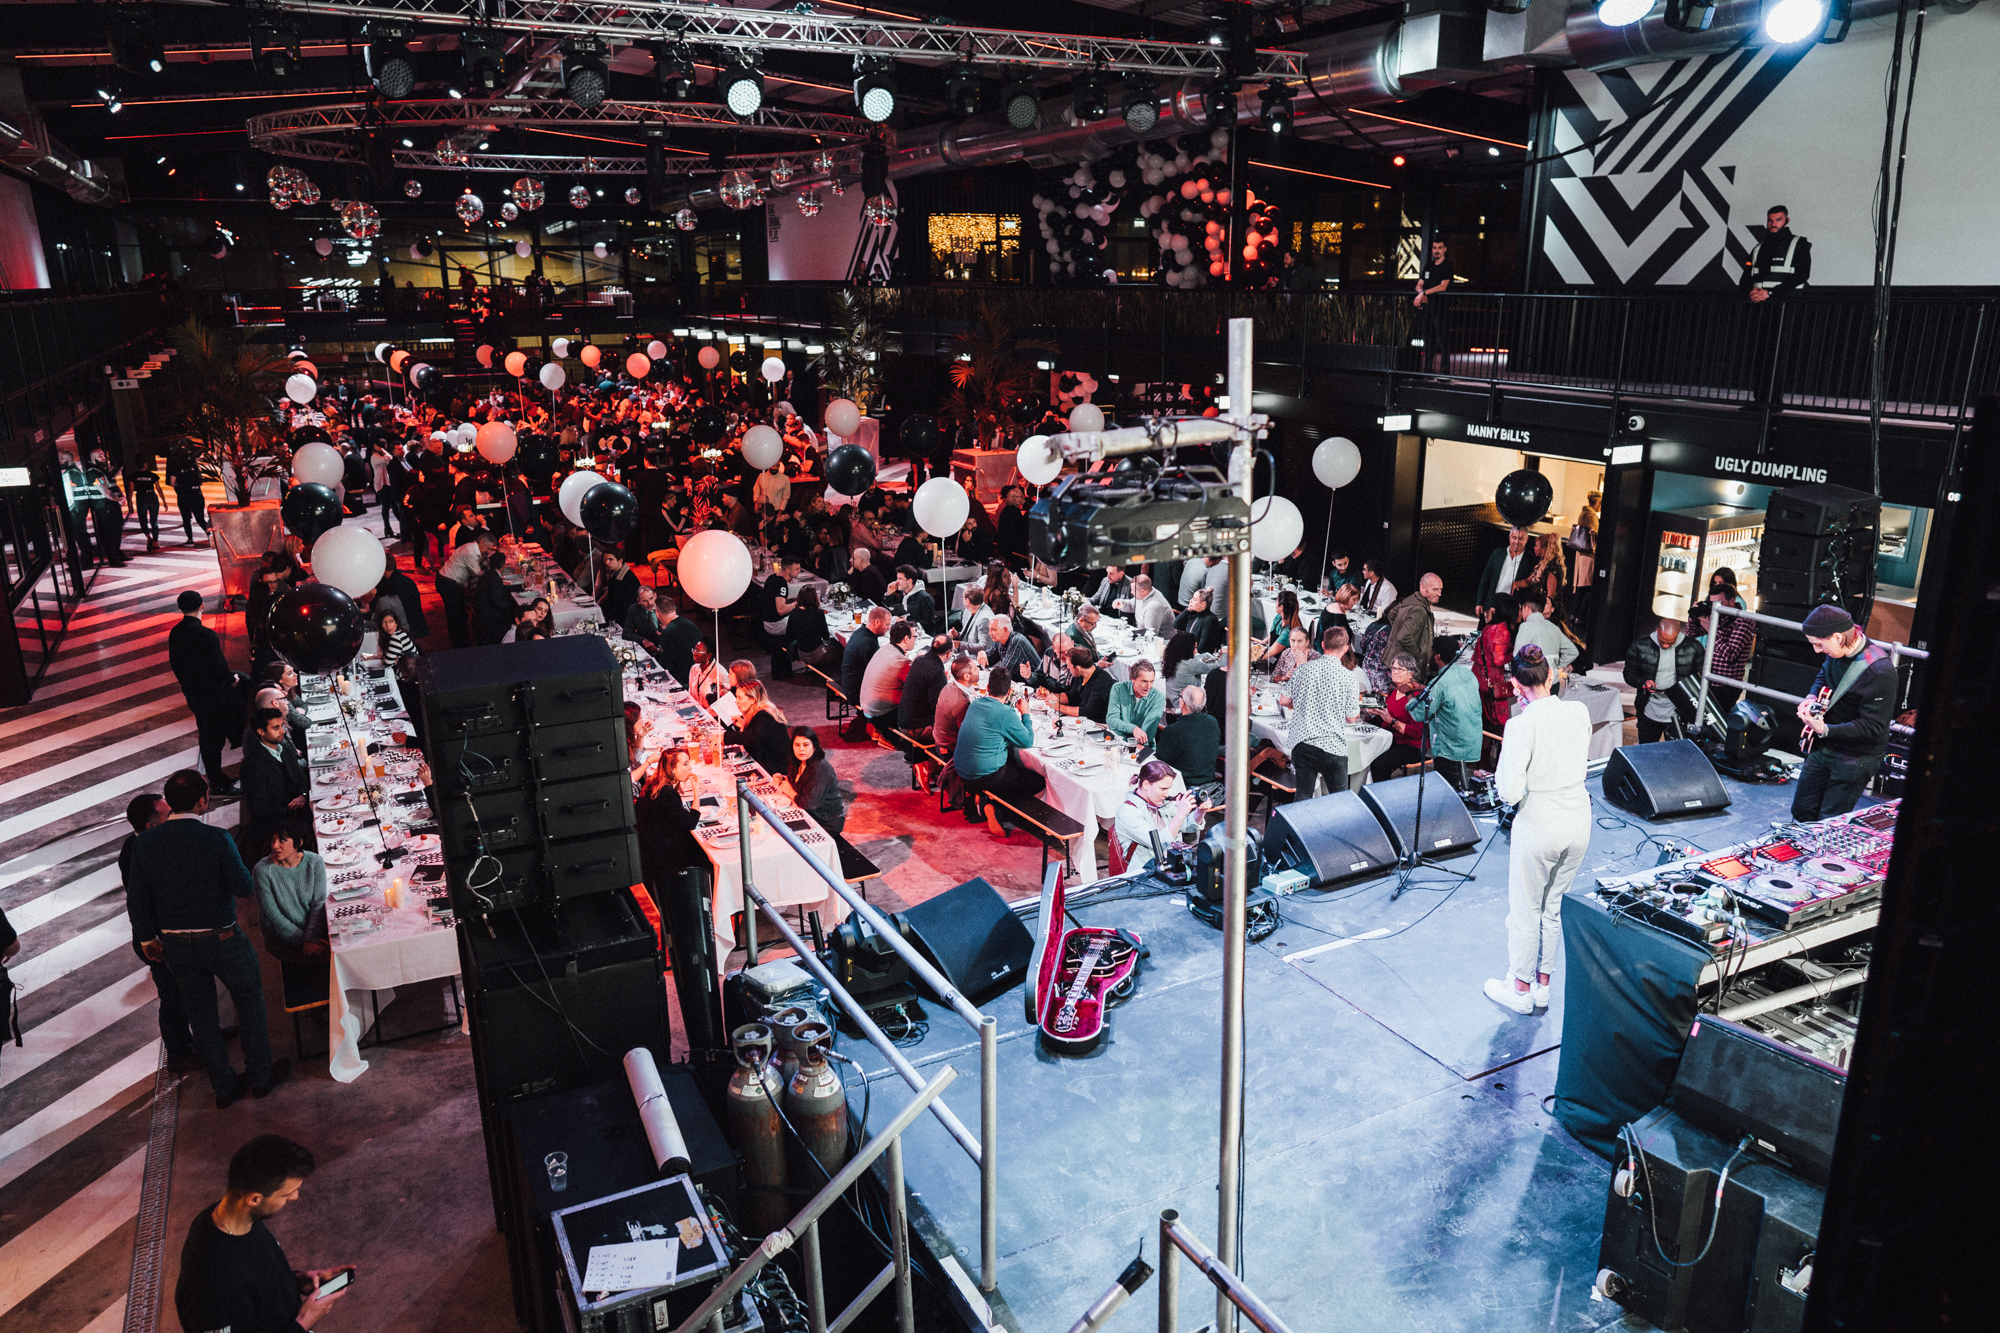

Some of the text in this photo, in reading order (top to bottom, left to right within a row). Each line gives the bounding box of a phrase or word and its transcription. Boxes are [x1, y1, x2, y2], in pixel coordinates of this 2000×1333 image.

[1466, 423, 1500, 440] NANNY
[1714, 456, 1828, 484] UGLY DUMPLING
